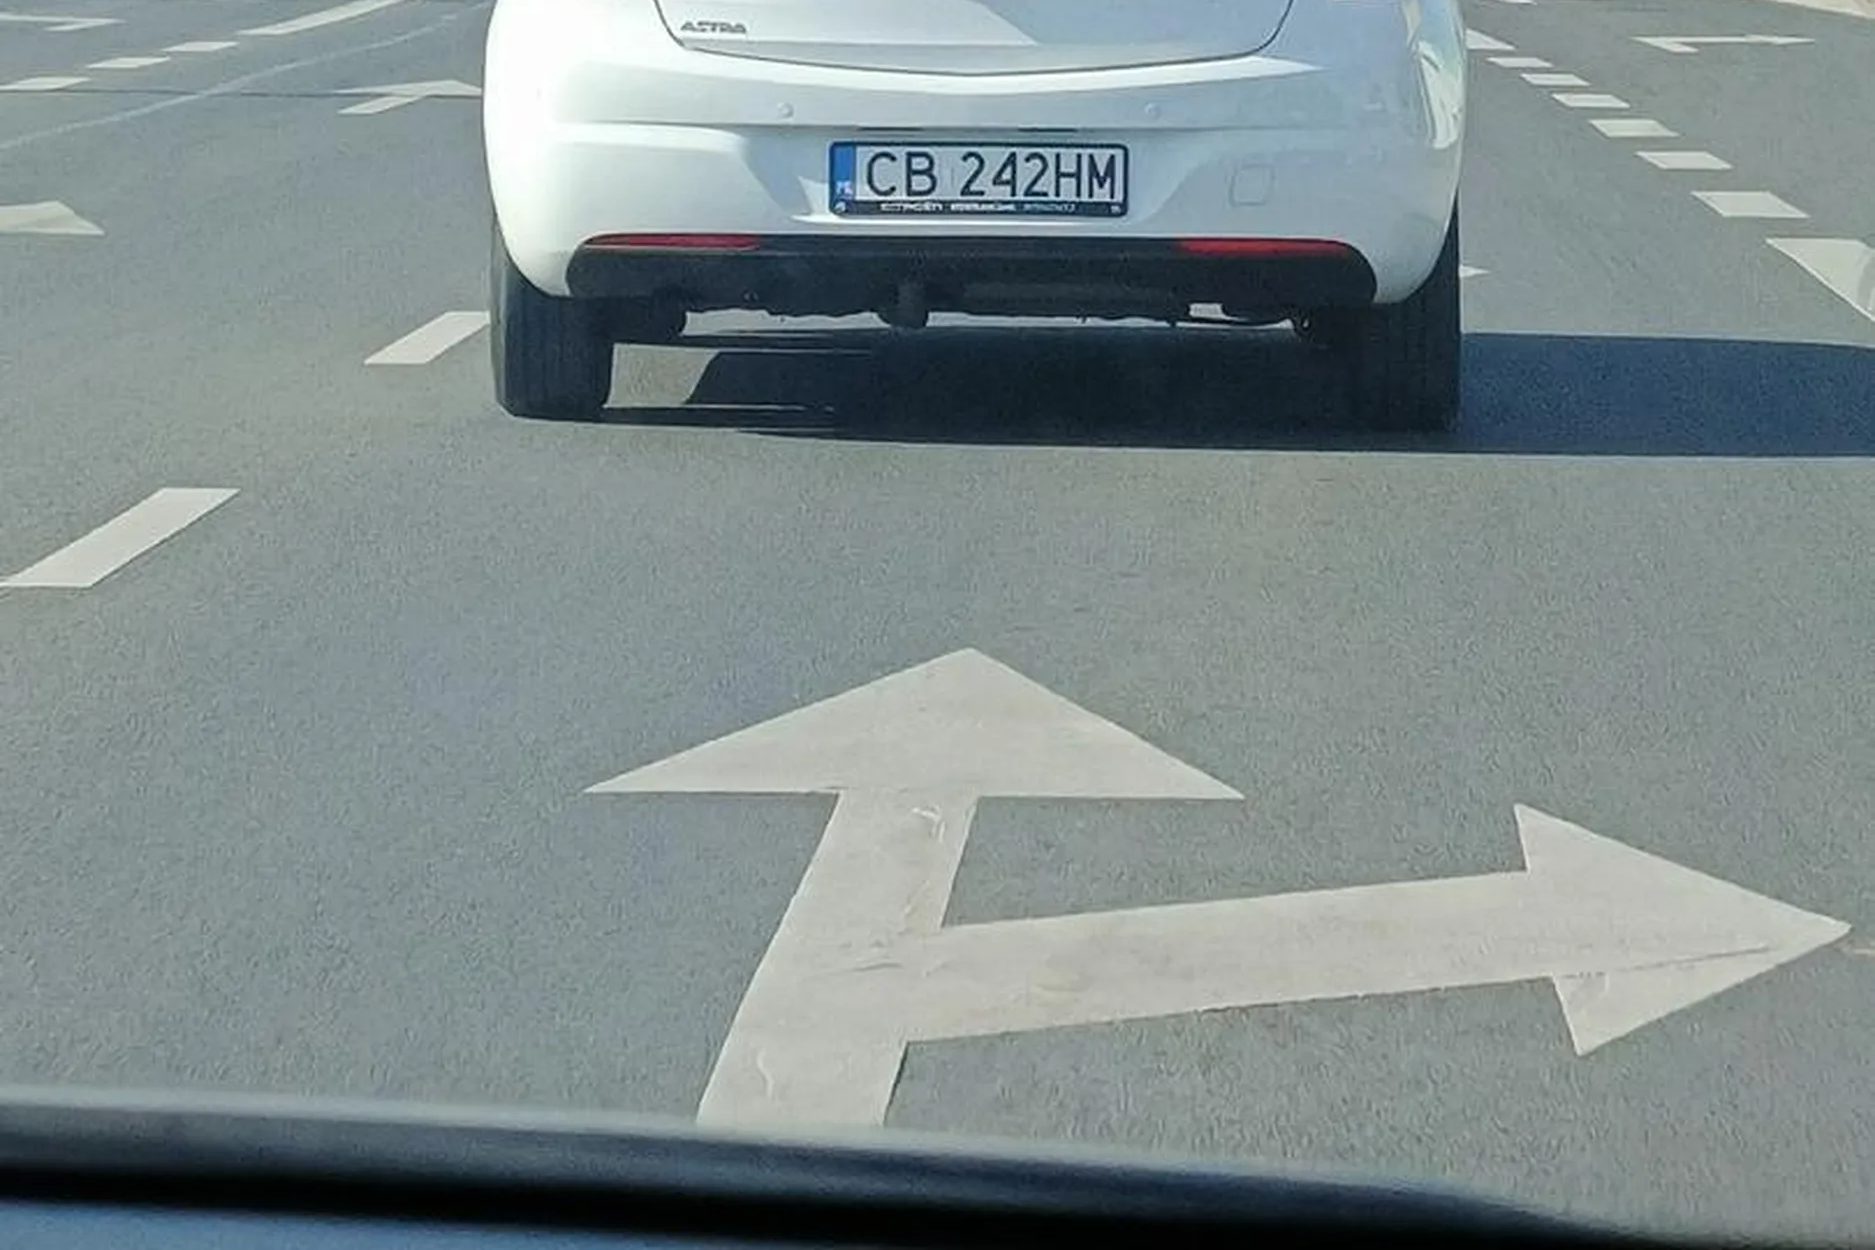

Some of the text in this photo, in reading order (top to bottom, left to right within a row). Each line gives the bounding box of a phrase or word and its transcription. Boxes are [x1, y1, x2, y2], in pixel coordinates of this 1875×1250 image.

[680, 20, 747, 34] ASTRA
[866, 151, 1117, 200] CB 242HM
